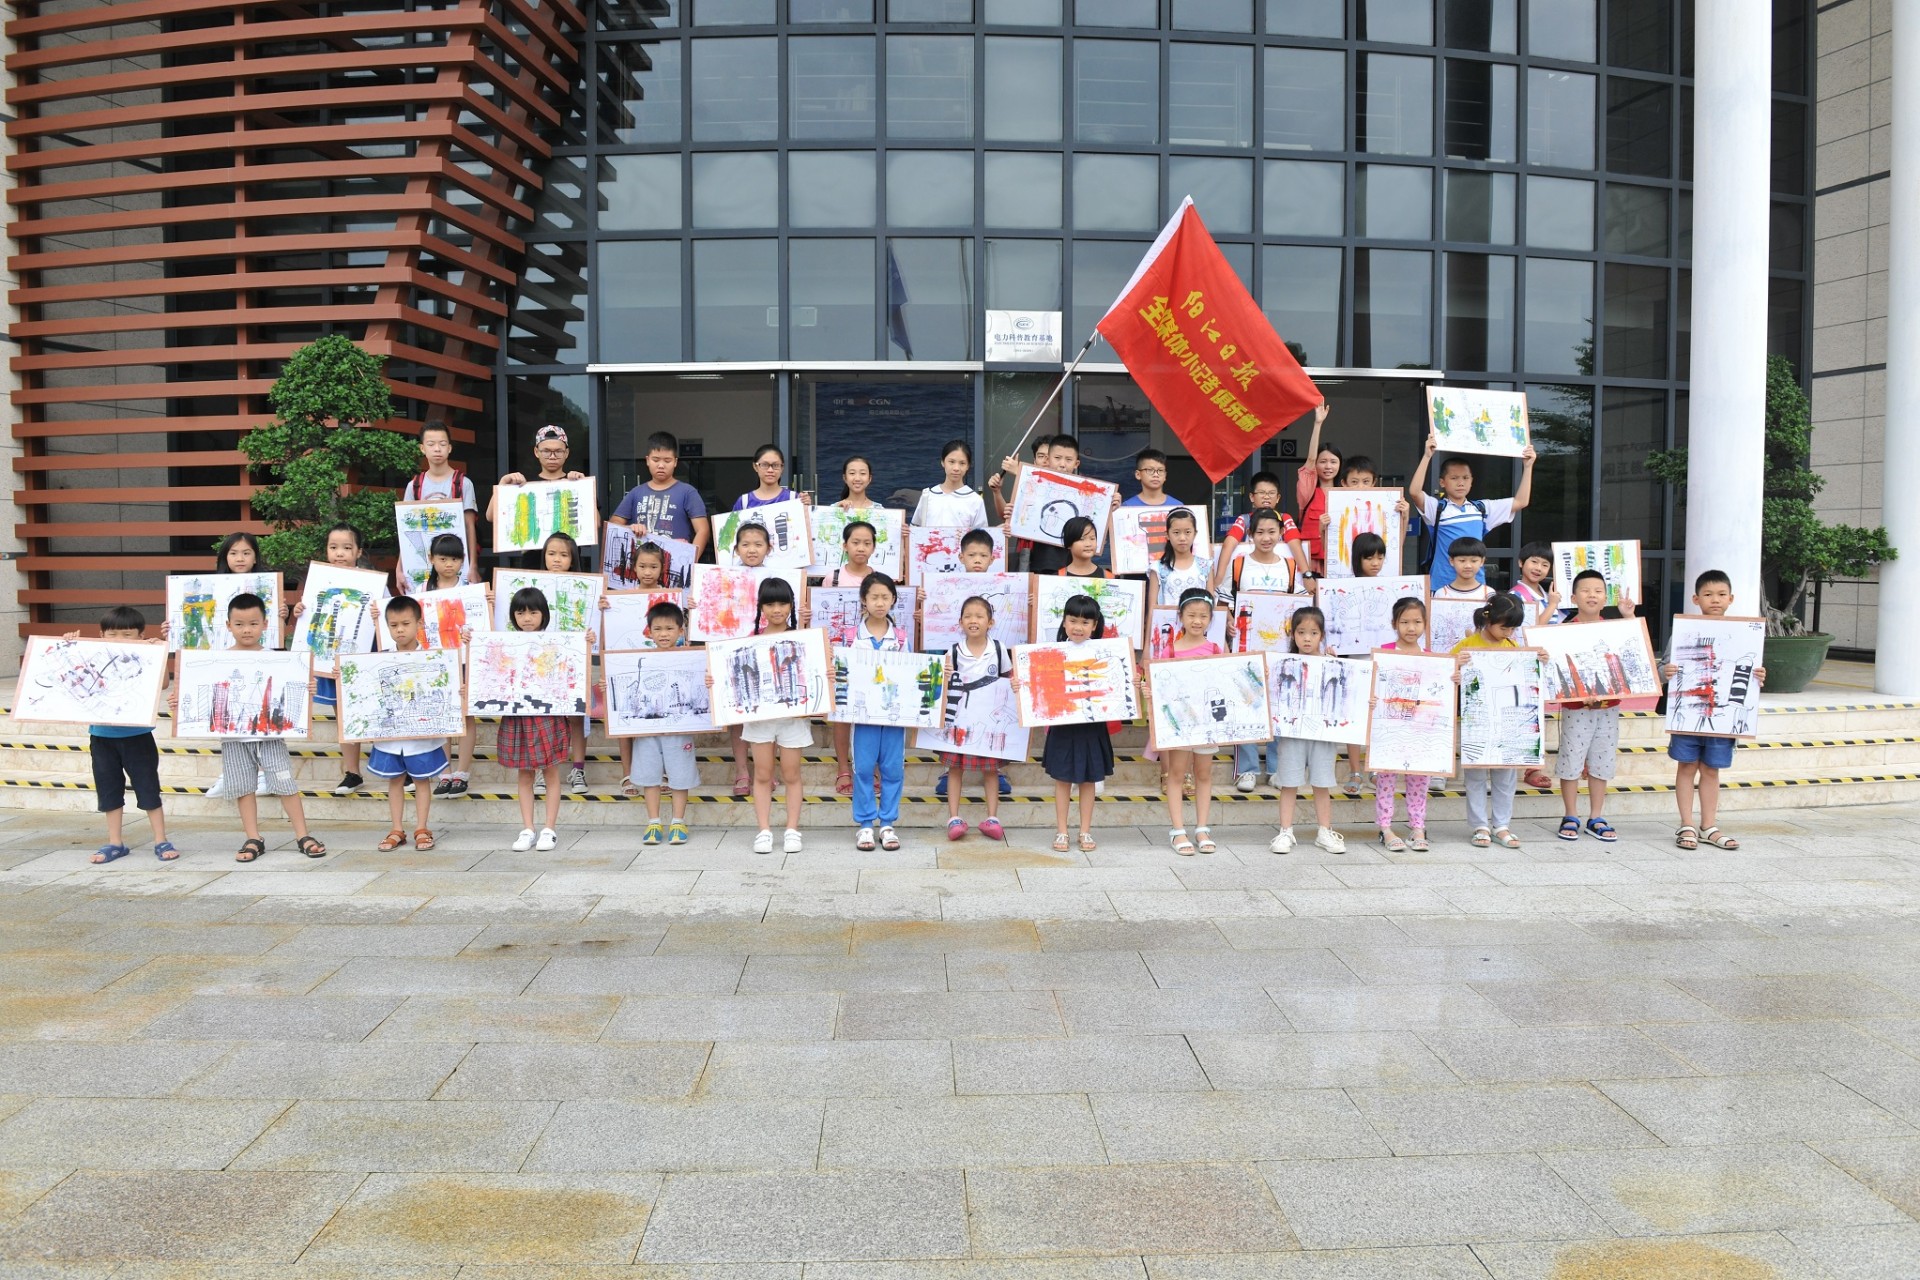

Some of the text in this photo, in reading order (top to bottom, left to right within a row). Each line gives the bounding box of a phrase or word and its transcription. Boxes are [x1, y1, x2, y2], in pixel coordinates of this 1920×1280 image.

[1180, 291, 1260, 392] 阳江日报
[868, 398, 891, 406] CGN
